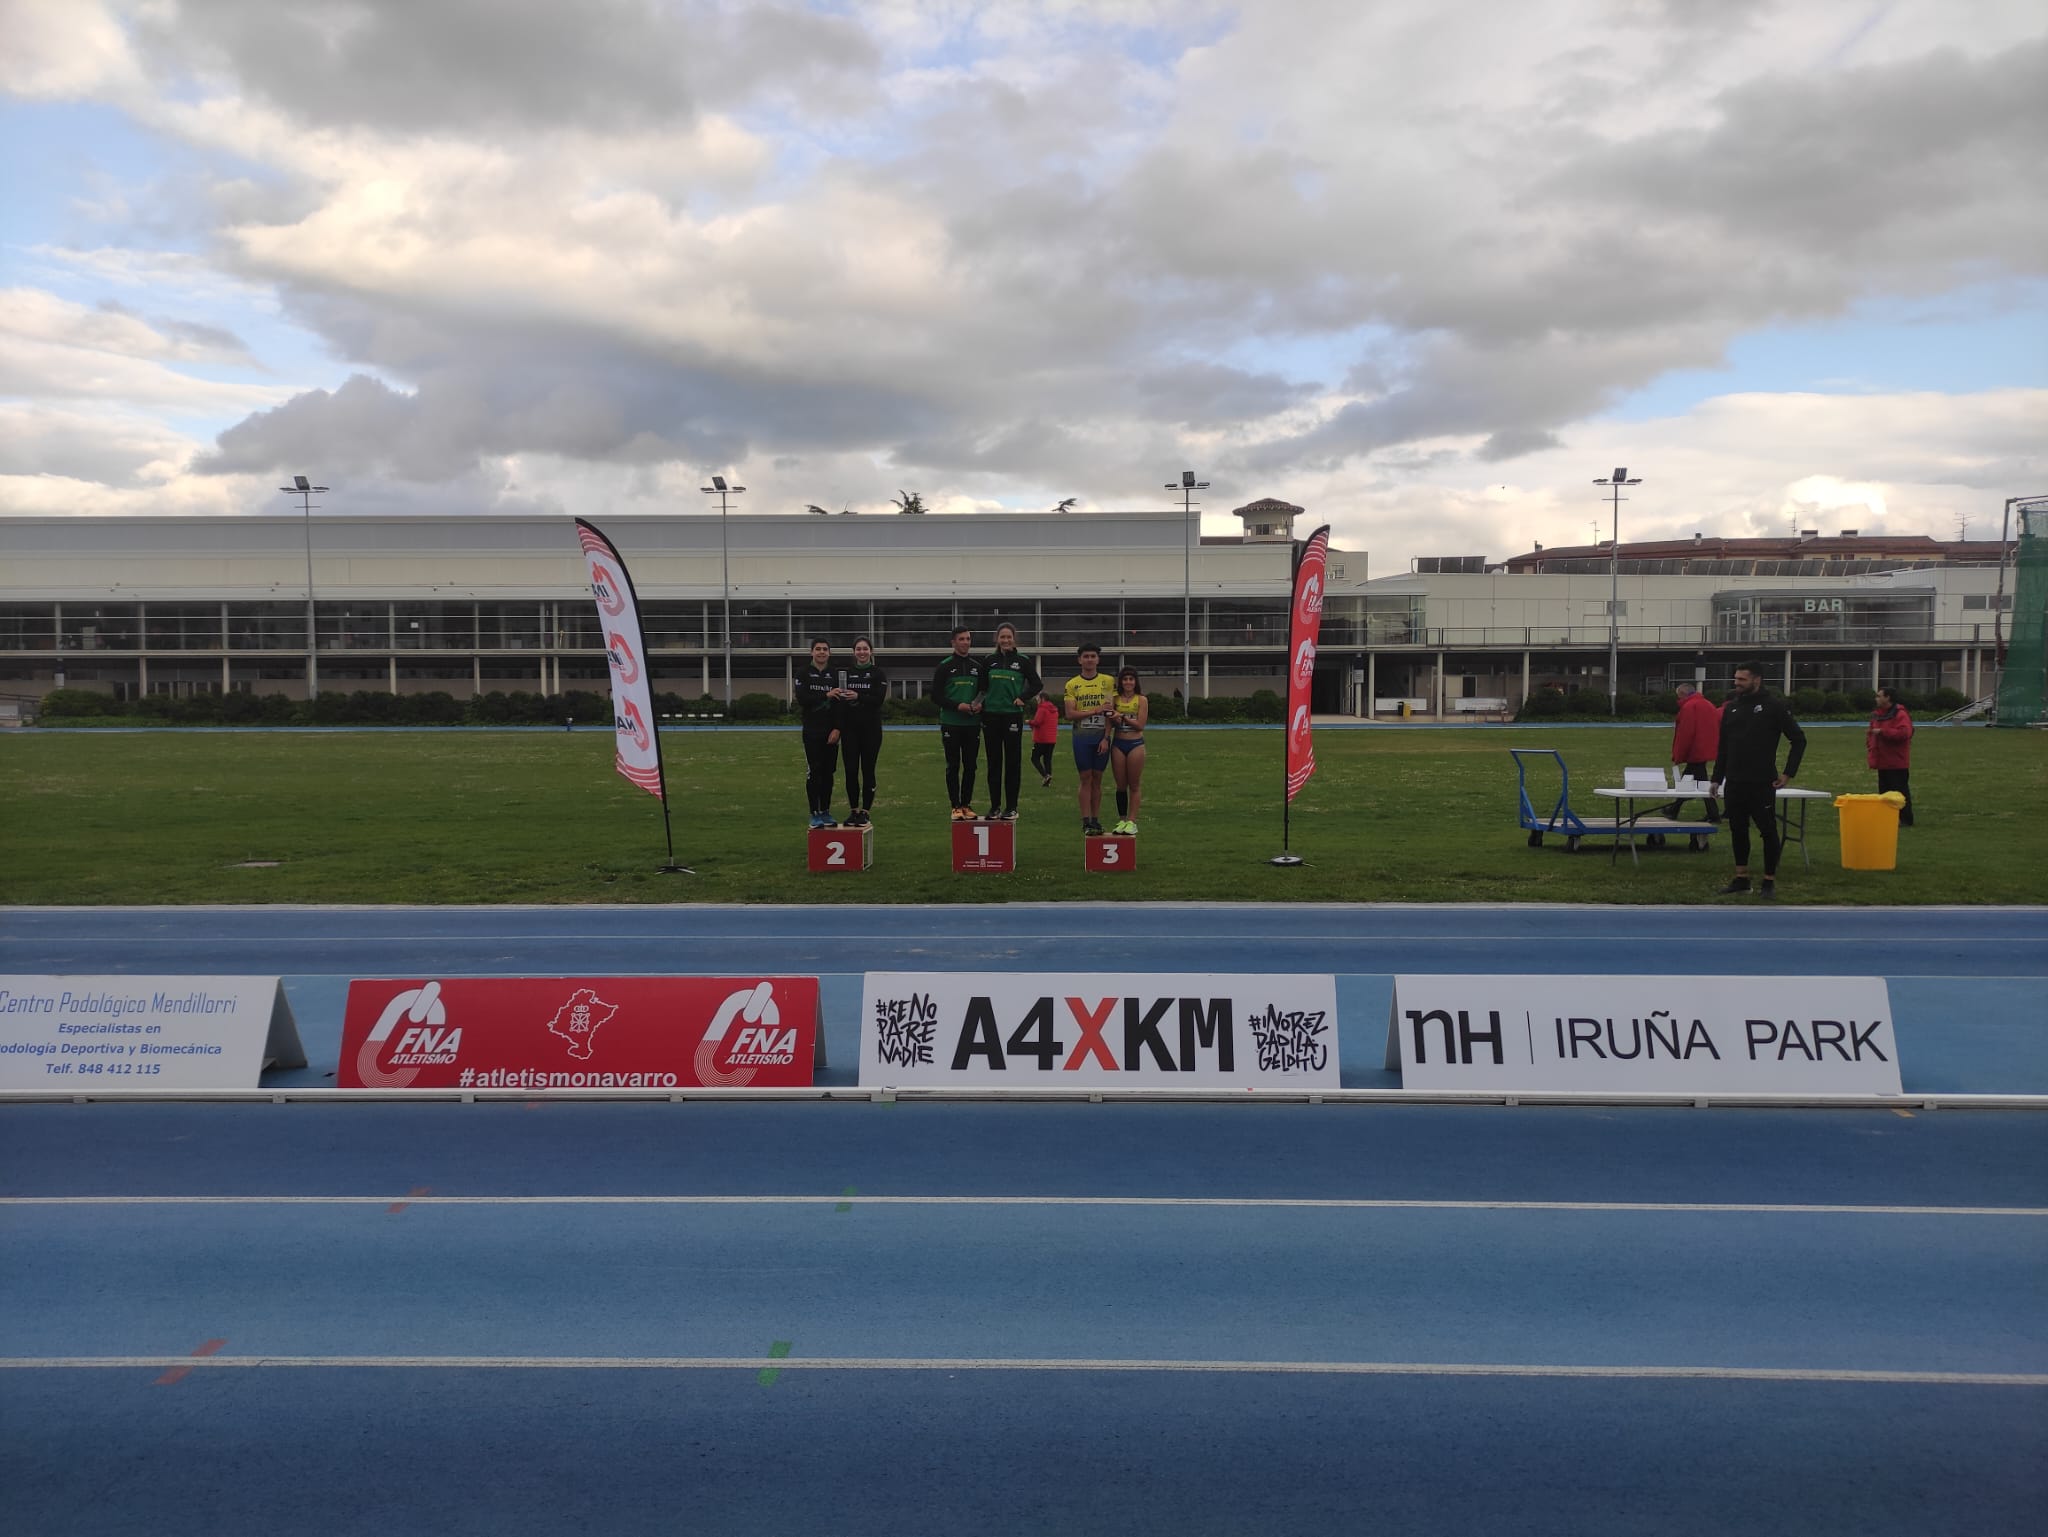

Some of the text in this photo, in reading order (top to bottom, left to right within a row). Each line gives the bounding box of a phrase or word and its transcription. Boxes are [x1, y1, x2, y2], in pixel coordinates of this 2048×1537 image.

[1805, 598, 1843, 612] BAR
[825, 841, 846, 865] 2
[973, 826, 990, 856] 1
[1102, 843, 1119, 864] 3
[0, 991, 238, 1018] Centro Podológico Mendillorri
[58, 1022, 161, 1036] Especialistas en
[396, 1028, 462, 1053] FNA
[731, 1028, 798, 1053] FNA
[875, 1015, 938, 1047] PARE
[951, 997, 1234, 1072] A4XKM
[1555, 1010, 1888, 1062] IRUÑA PARK
[0, 1041, 222, 1057] odología Deportiva y Biomecánica
[388, 1053, 457, 1065] ATLETISMO
[725, 1053, 794, 1065] ATLETISMO
[878, 1039, 935, 1067] NADIE
[1258, 1044, 1327, 1072] GELDITU
[46, 1063, 160, 1075] Telf. 848 412 115
[459, 1068, 677, 1087] #atletismonavarro
